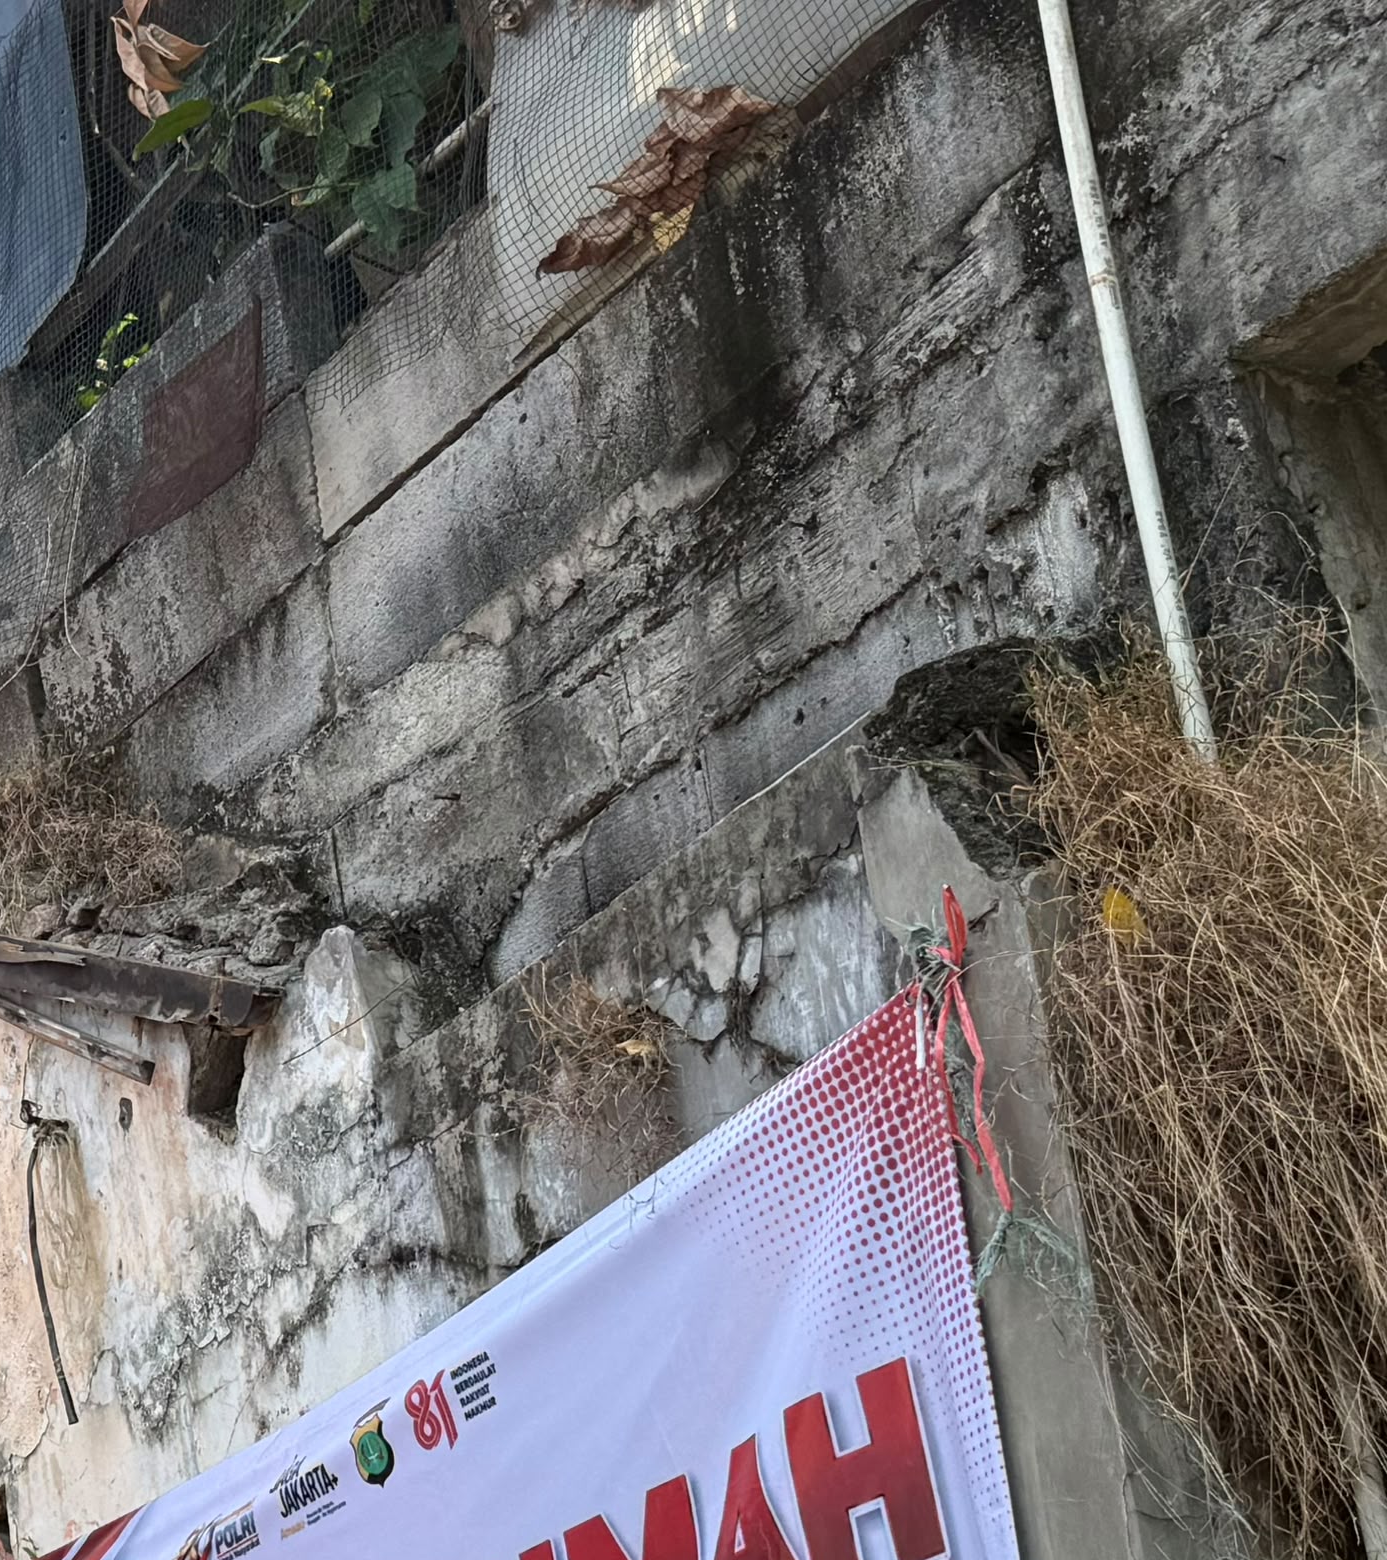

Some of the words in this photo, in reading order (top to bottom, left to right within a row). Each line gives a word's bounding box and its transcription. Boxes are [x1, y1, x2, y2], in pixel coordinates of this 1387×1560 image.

[449, 1351, 490, 1381] INDONESIA
[454, 1363, 497, 1395] BERDAULAT
[404, 1368, 458, 1450] 81
[463, 1396, 497, 1421] MAKMUR
[215, 1511, 257, 1555] POLRI
